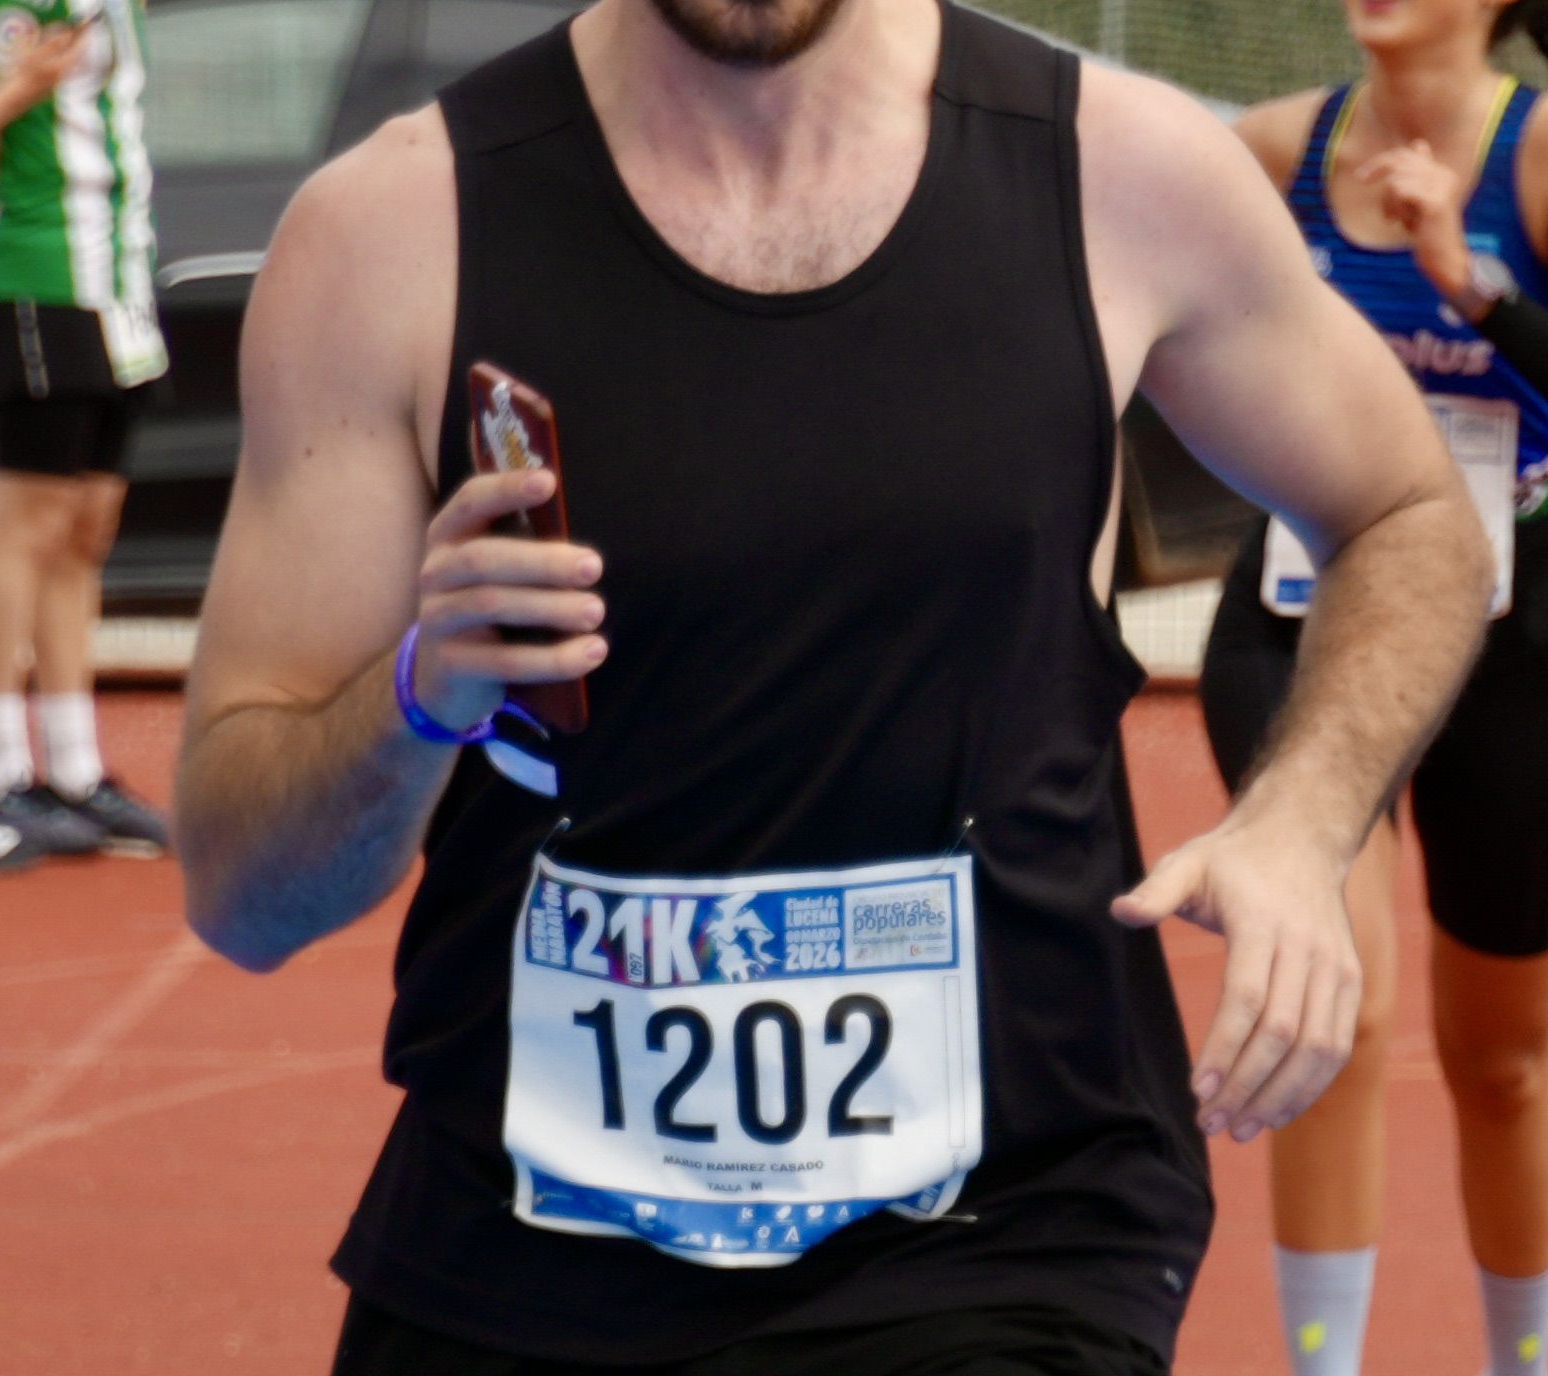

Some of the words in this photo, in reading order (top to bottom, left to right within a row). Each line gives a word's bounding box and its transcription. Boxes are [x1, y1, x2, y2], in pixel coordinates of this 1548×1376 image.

[853, 898, 932, 917] carreras
[568, 888, 701, 984] 21K
[853, 910, 947, 936] populares
[786, 941, 841, 971] 2026
[573, 993, 894, 1145] 1202
[663, 1155, 702, 1169] MARIO
[770, 1160, 824, 1172] CASADO
[707, 1182, 743, 1192] TALLA
[751, 1181, 763, 1192] M
